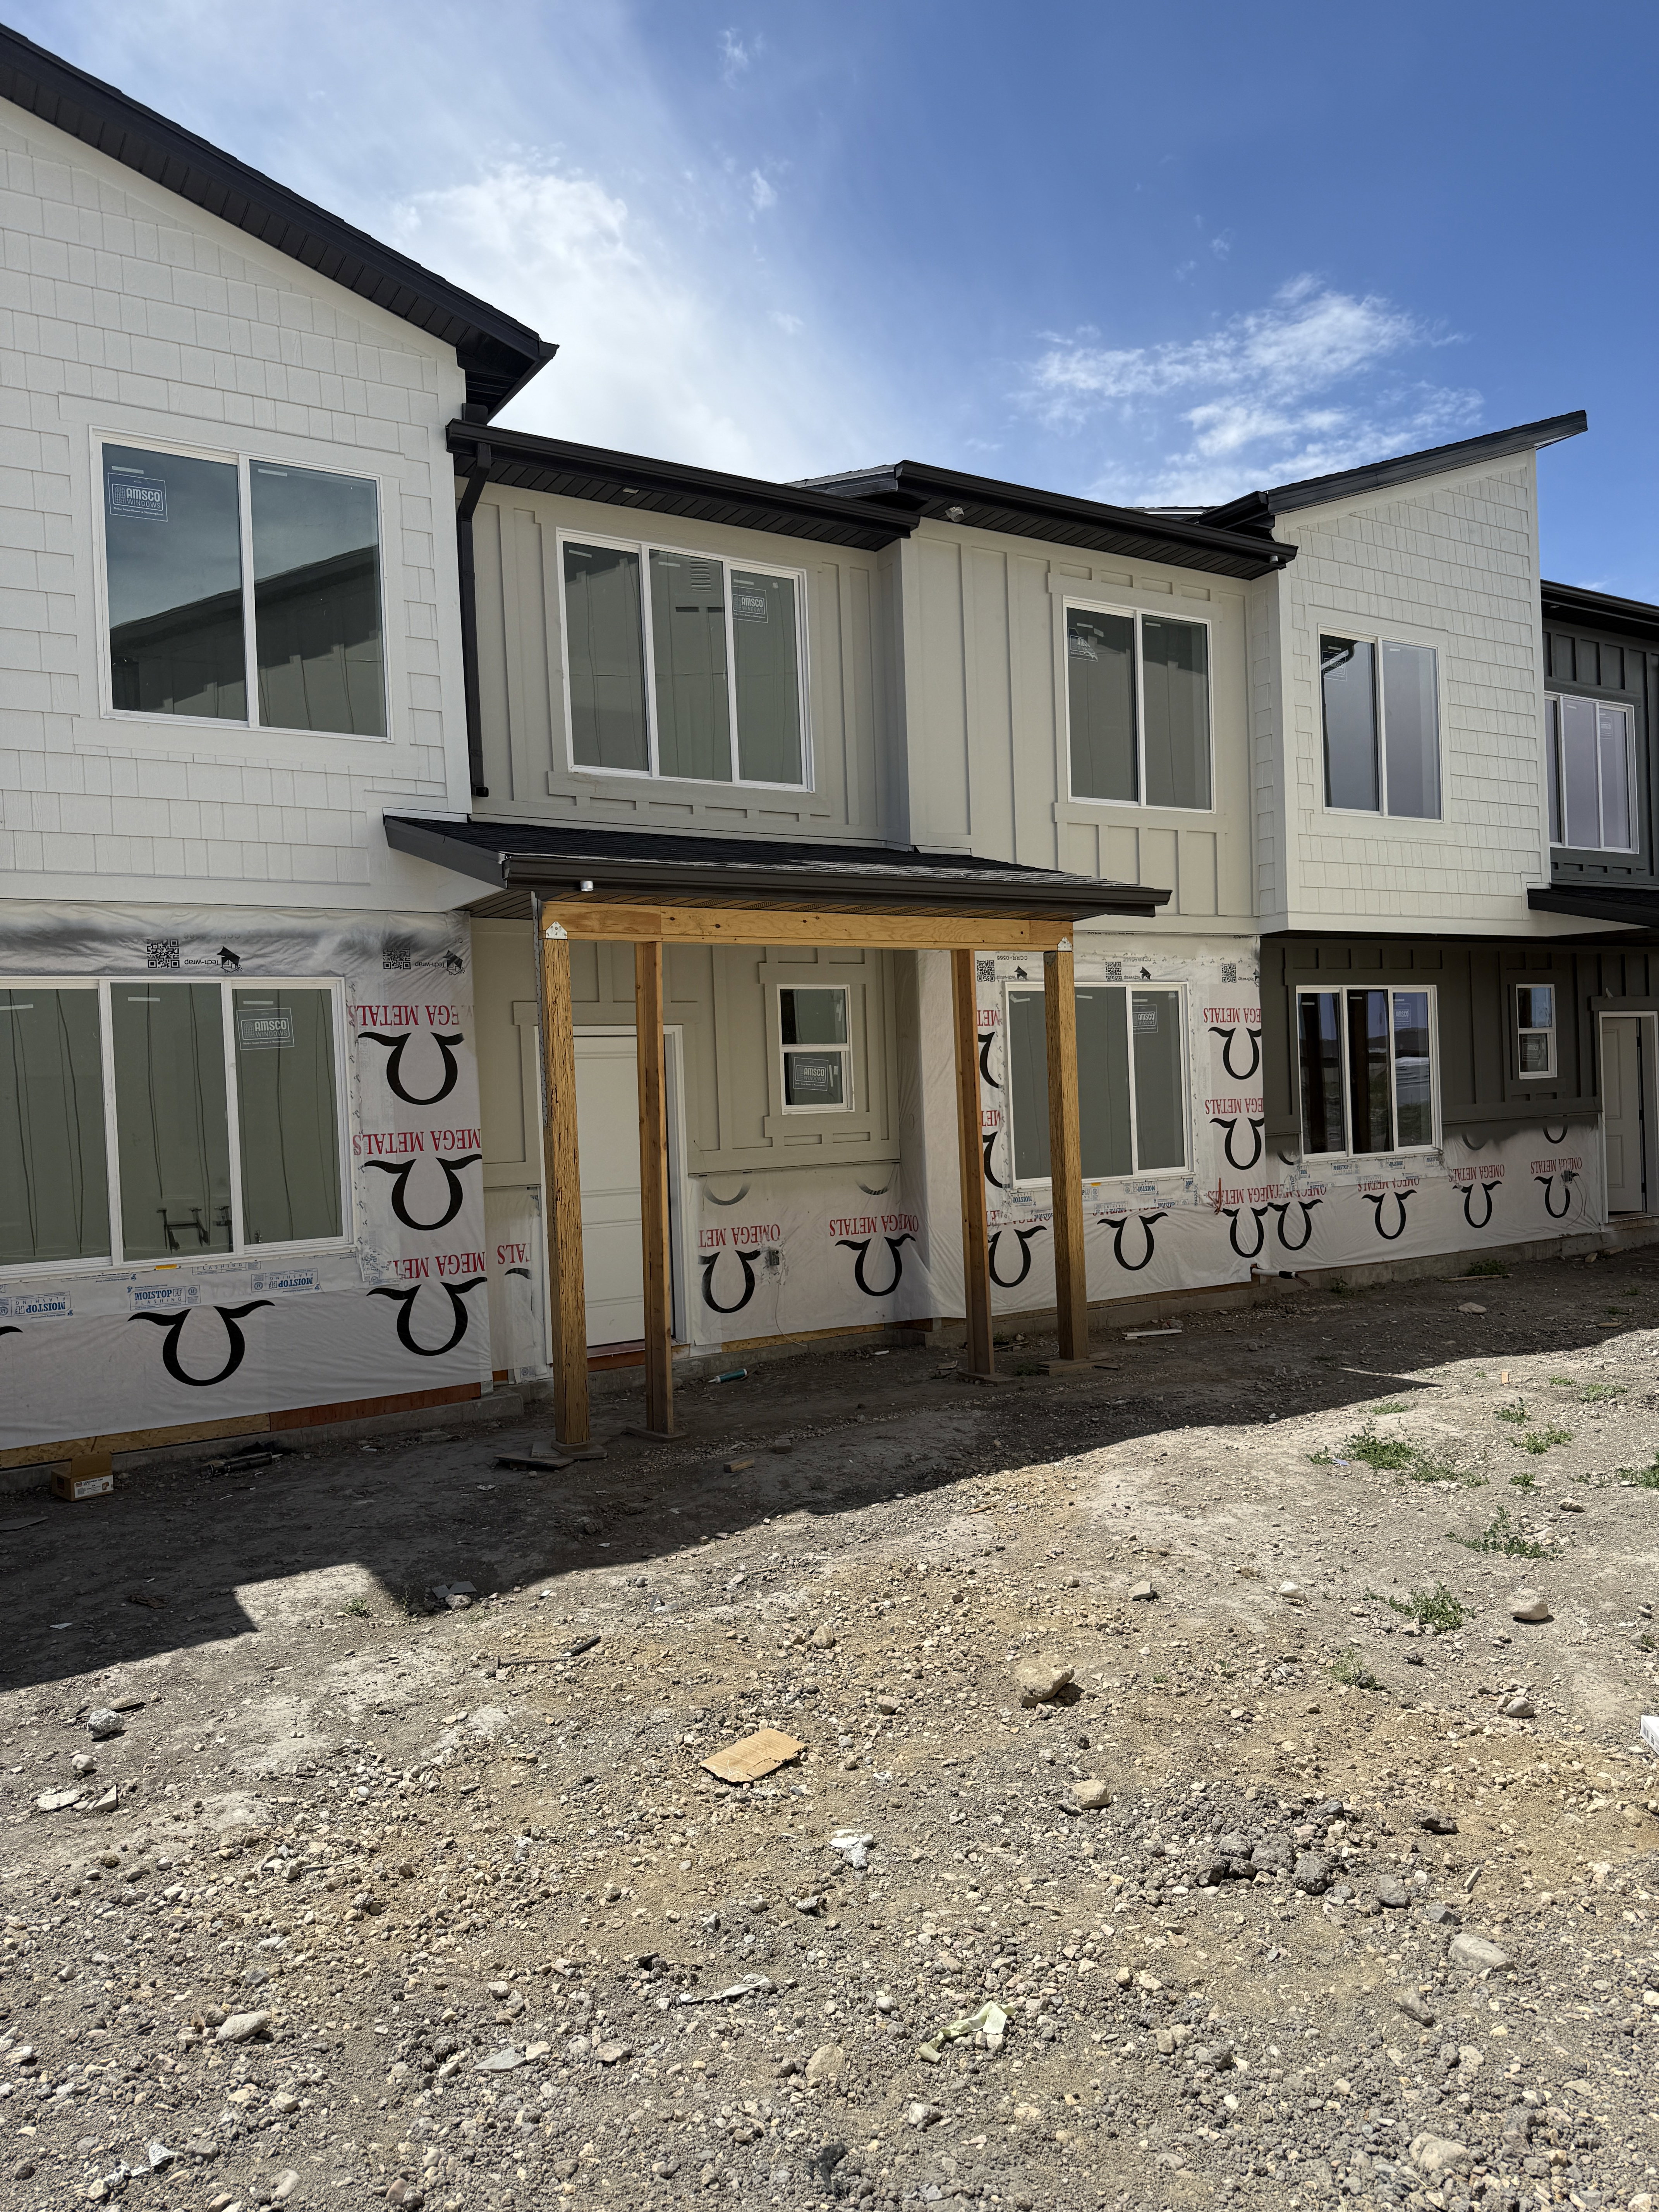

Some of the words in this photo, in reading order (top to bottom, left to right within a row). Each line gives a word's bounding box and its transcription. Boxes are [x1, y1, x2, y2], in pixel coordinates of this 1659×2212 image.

[126, 488, 160, 502] AMSCO
[127, 498, 161, 509] WINDOWS
[741, 597, 763, 608] AMSCO
[348, 1005, 419, 1027] METALS
[1138, 1013, 1154, 1021] AMSCO
[1204, 1008, 1240, 1023] METALS
[254, 1020, 287, 1031] AMSCO
[804, 1067, 824, 1077] AMSCO
[1205, 1098, 1242, 1115] METALS
[352, 1131, 424, 1156] METALS
[1479, 1164, 1505, 1180] OMEGA
[1530, 1159, 1556, 1174] METALS
[829, 1216, 878, 1237] METALS
[881, 1214, 919, 1232] OMEGA
[698, 1228, 727, 1248] MET
[731, 1224, 781, 1245] OMEGA
[270, 1273, 313, 1281] FLASHING
[278, 1277, 313, 1288] MOISTOP
[15, 1297, 65, 1305] FLASHING
[135, 1289, 172, 1300] MOISTOP
[135, 1297, 182, 1305] FLASHING
[26, 1301, 66, 1313] MOISTOP
